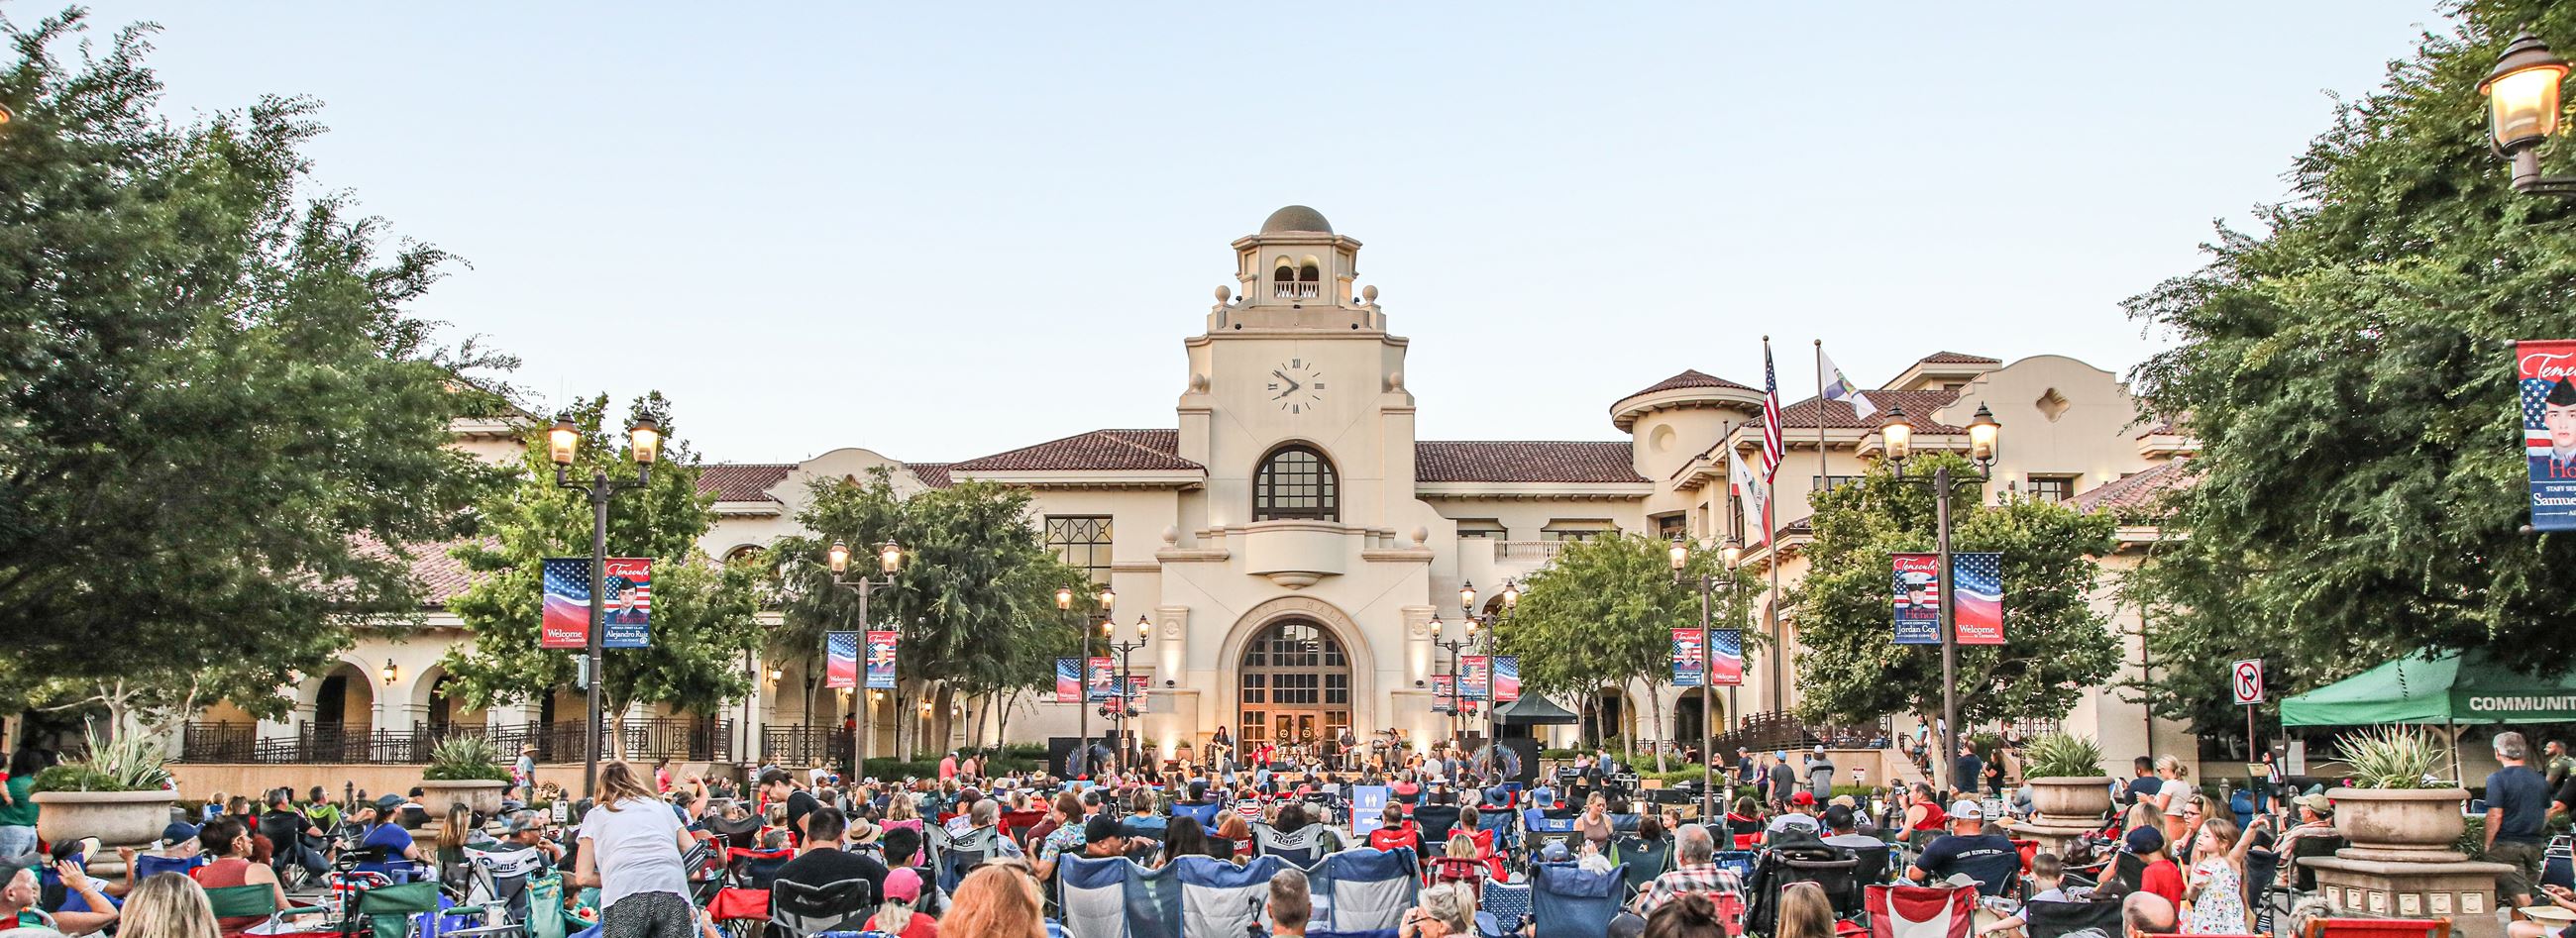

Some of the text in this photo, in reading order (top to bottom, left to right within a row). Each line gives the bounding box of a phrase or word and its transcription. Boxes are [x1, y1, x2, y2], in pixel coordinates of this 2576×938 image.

[2520, 352, 2576, 382] Teme
[547, 629, 583, 638] Welcome
[1897, 624, 1921, 634] Jordan
[1958, 624, 1994, 633] Welcome
[605, 630, 635, 639] Alejandro
[2469, 696, 2576, 711] COMMUNIT
[1272, 832, 1305, 846] Rams
